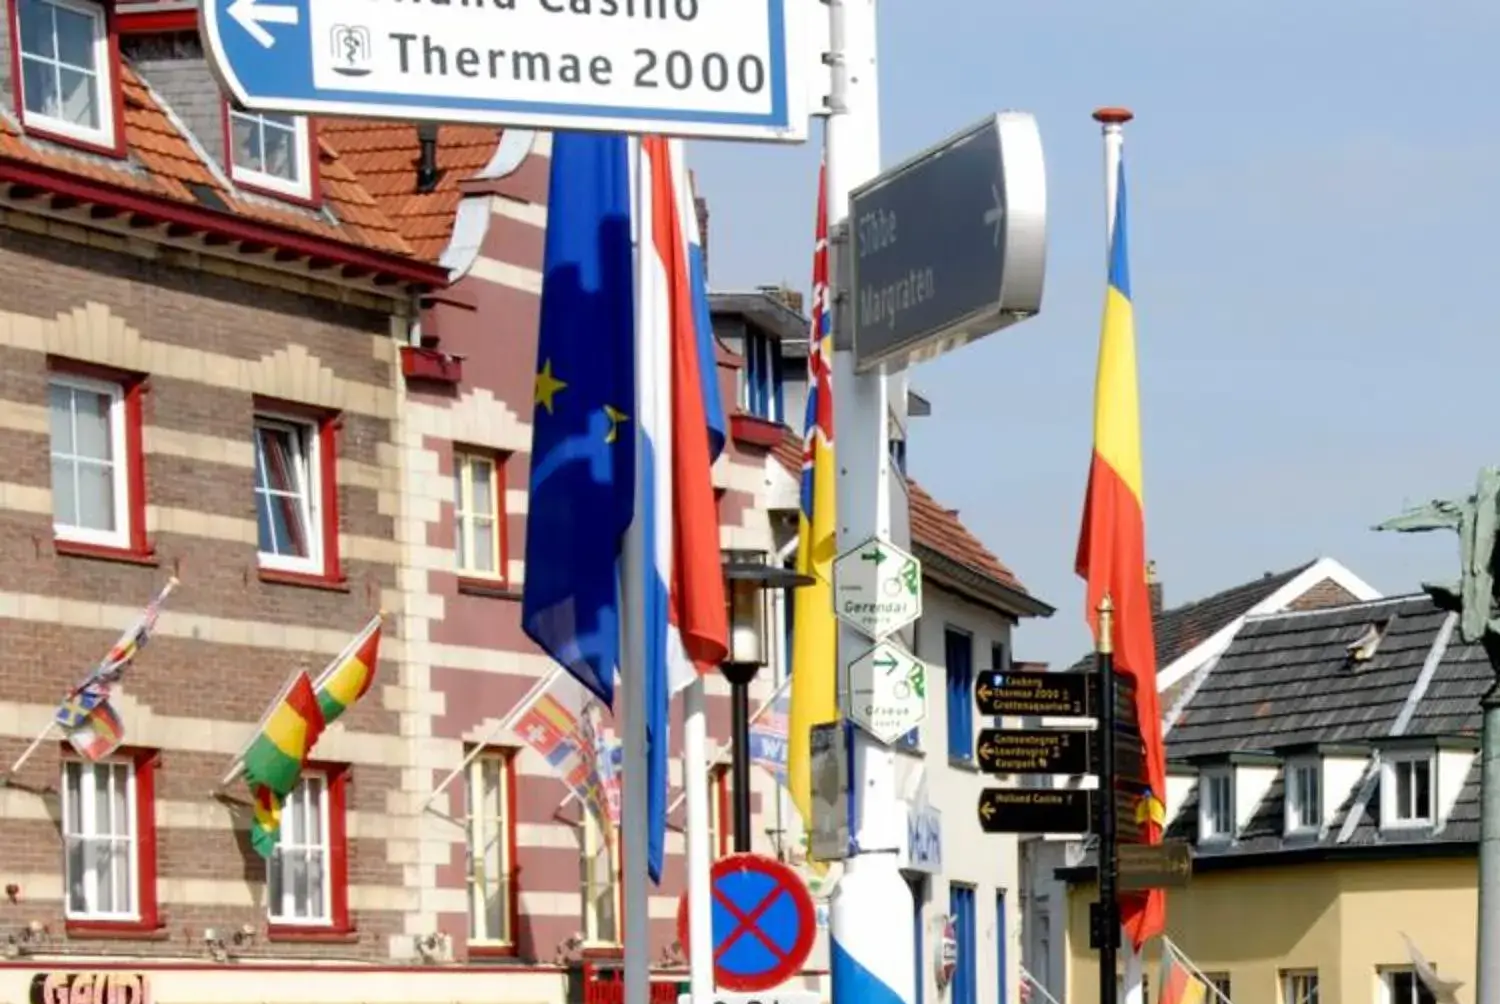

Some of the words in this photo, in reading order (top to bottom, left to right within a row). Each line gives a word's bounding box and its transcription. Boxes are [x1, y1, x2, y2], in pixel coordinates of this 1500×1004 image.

[388, 33, 613, 86] Thermae
[633, 48, 765, 94] 2000
[860, 267, 935, 330] Margraten
[844, 600, 907, 614] Gerendal
